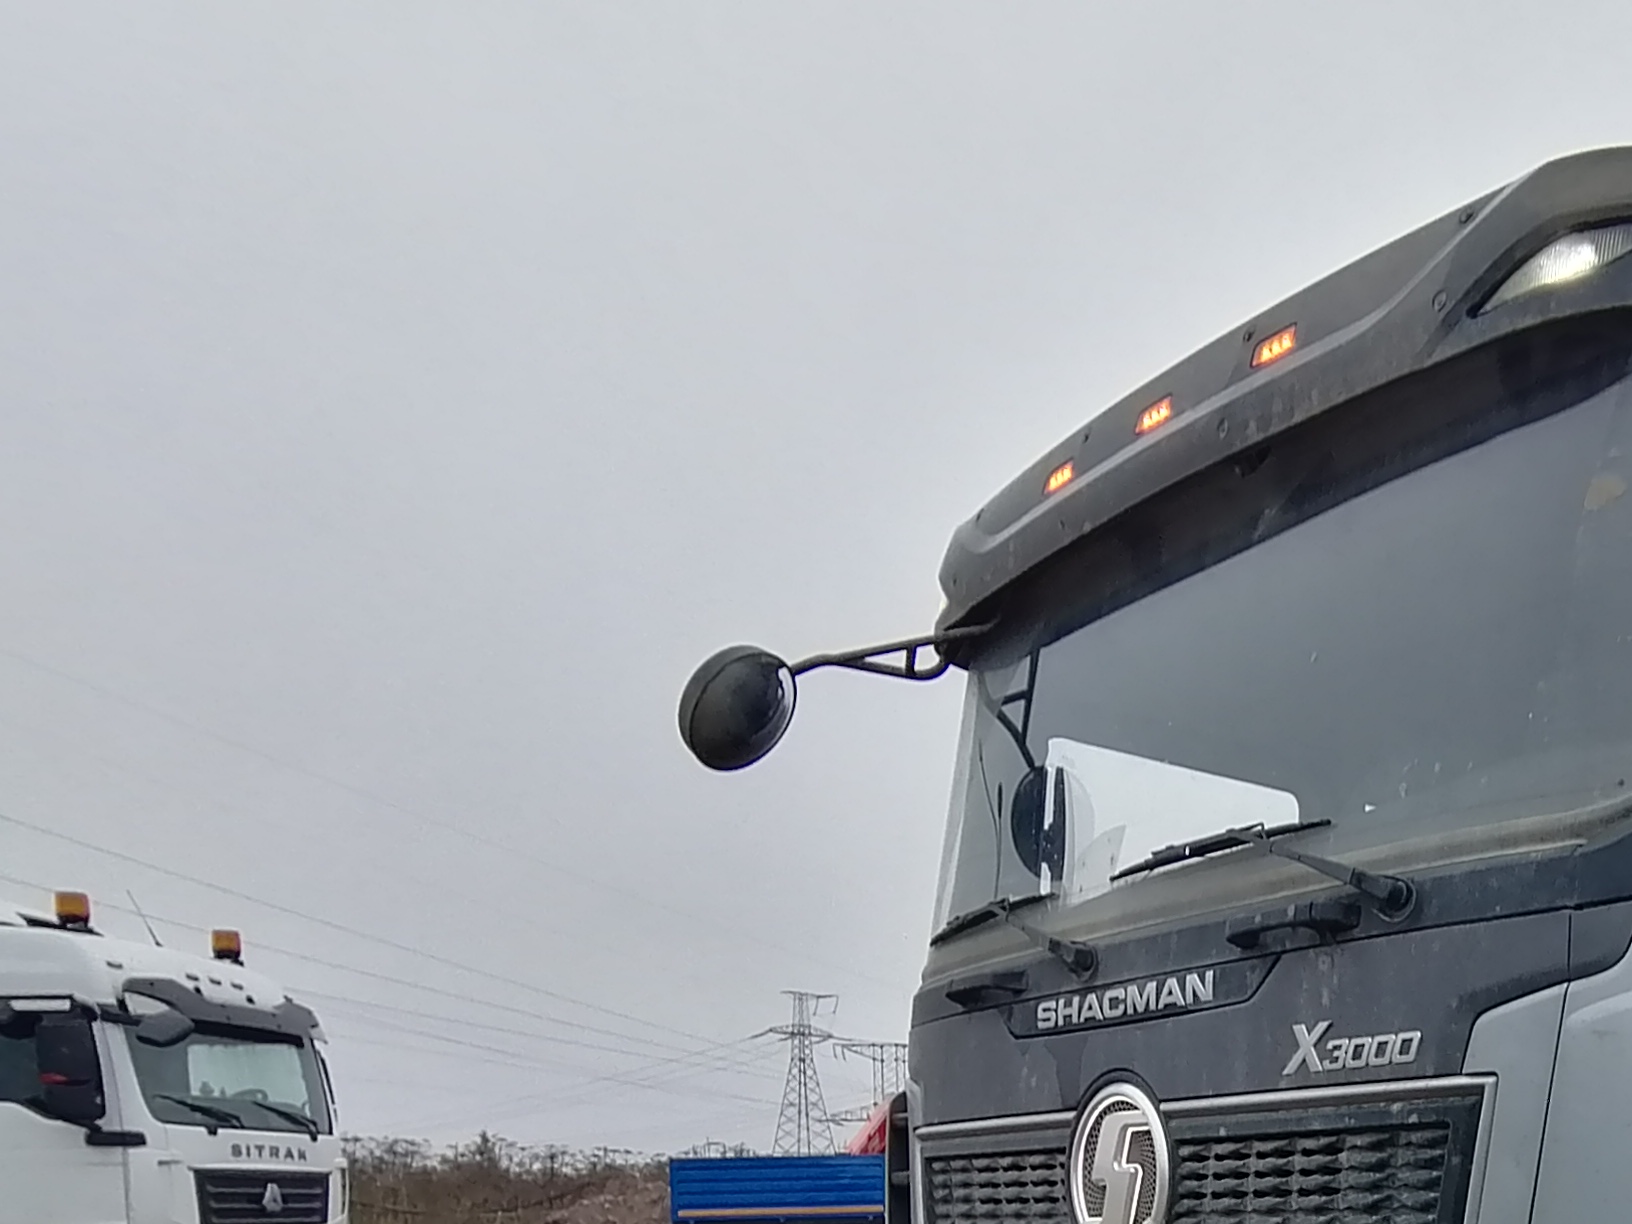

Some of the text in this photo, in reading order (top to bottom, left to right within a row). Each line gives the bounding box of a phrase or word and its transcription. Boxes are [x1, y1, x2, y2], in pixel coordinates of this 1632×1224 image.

[1036, 969, 1215, 1030] SHACMAN
[1282, 1020, 1422, 1076] X3000
[231, 1143, 307, 1162] SITRAK
